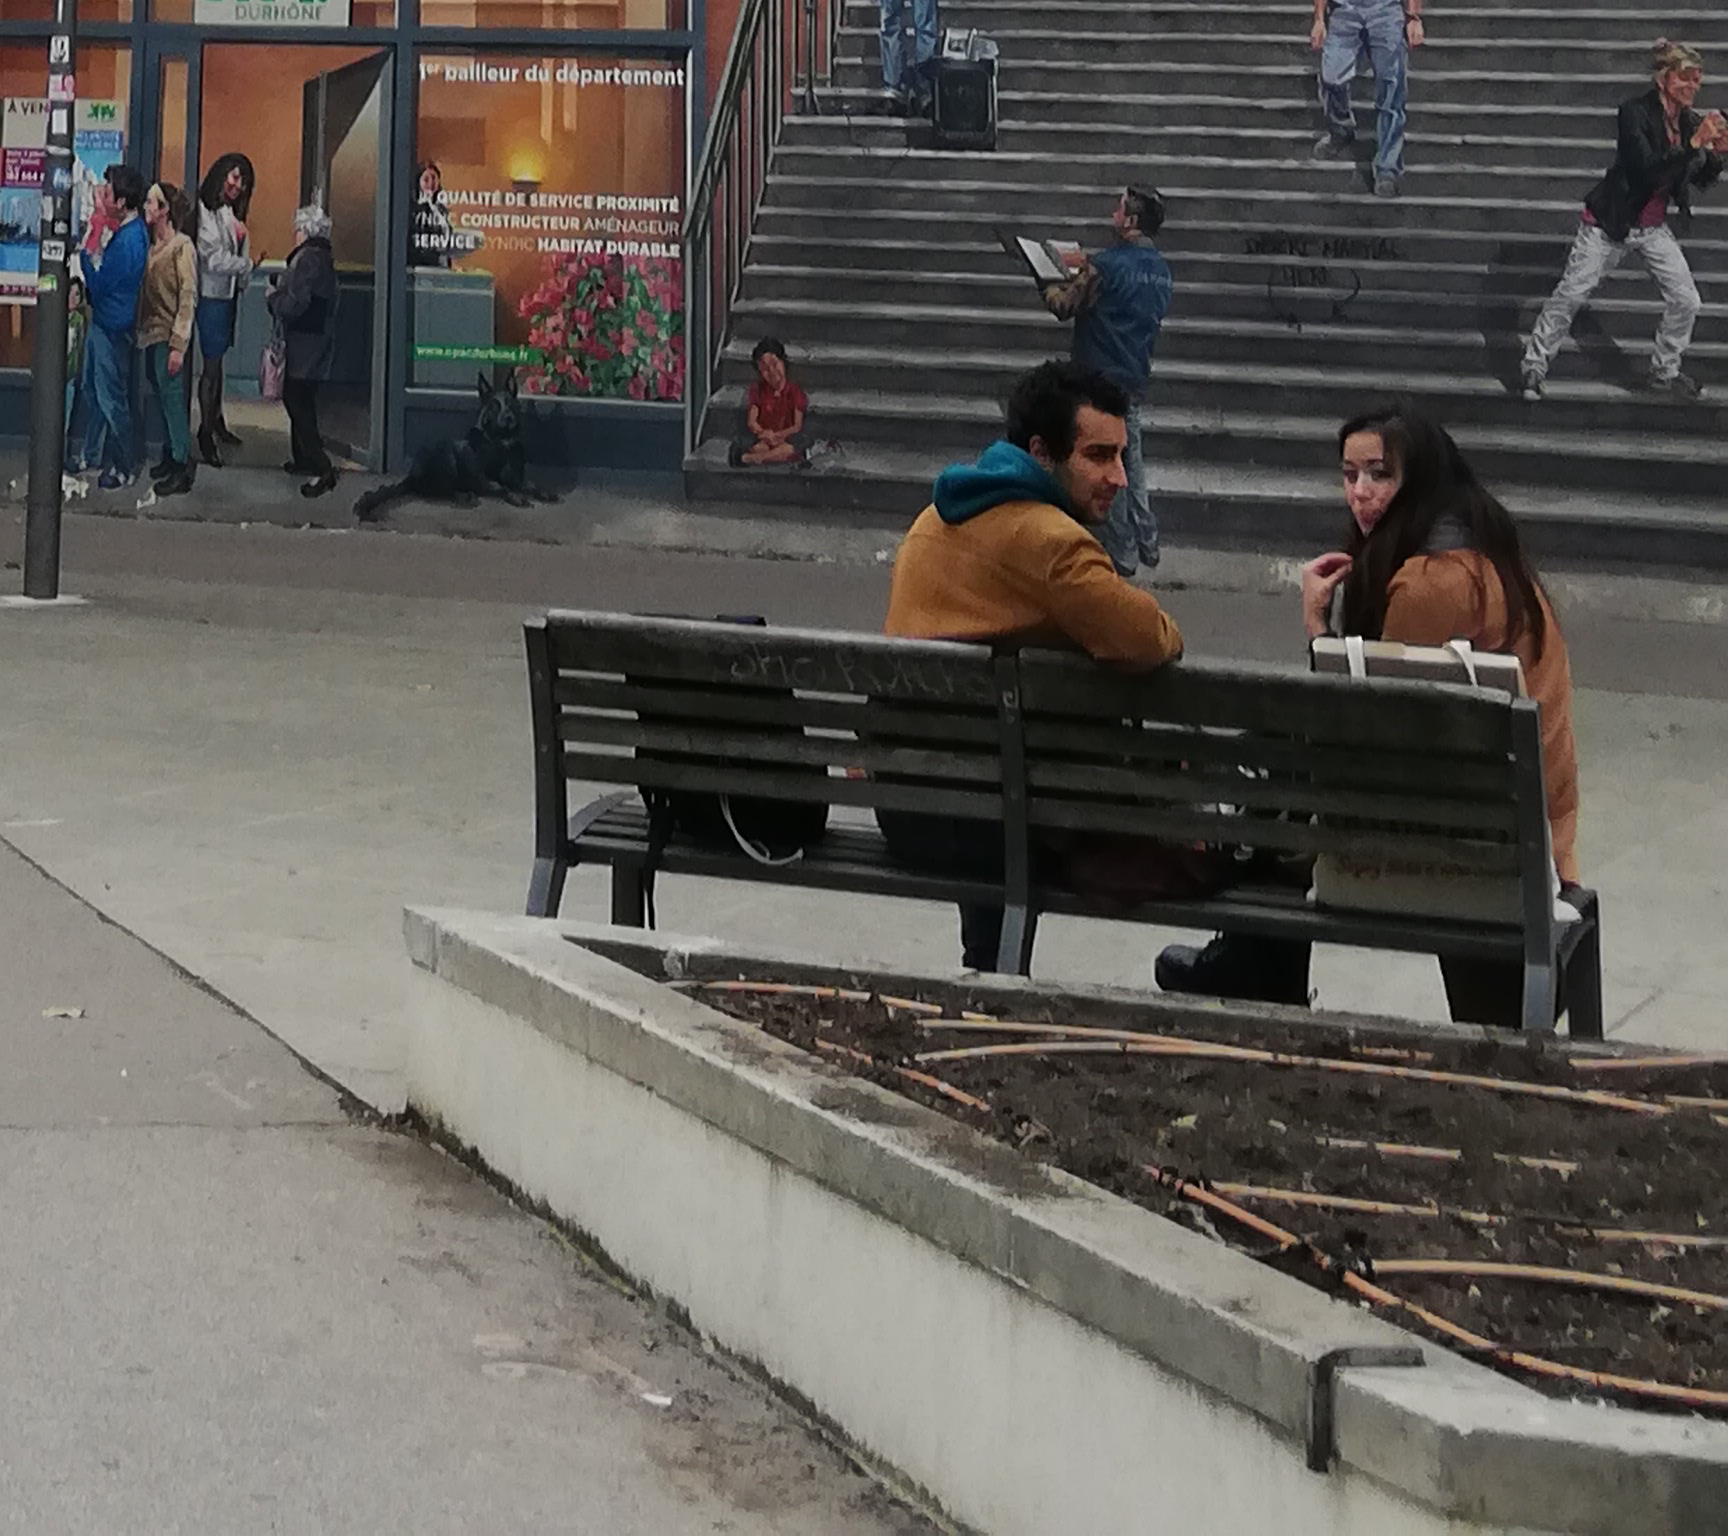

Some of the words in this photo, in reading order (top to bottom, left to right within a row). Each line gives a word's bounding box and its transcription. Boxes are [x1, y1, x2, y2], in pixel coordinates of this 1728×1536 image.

[444, 62, 520, 82] bailleur
[525, 64, 551, 82] du
[556, 64, 685, 88] département
[437, 189, 502, 207] QUALITÉ
[505, 192, 526, 207] DE
[529, 193, 594, 210] SERVICE
[596, 194, 680, 213] PROXIMITÉ
[460, 213, 580, 231] CONSTRUCTEUR
[583, 214, 680, 235] AMÉNAGEUR
[537, 236, 604, 254] HABITAT
[606, 238, 681, 258] DURABLE
